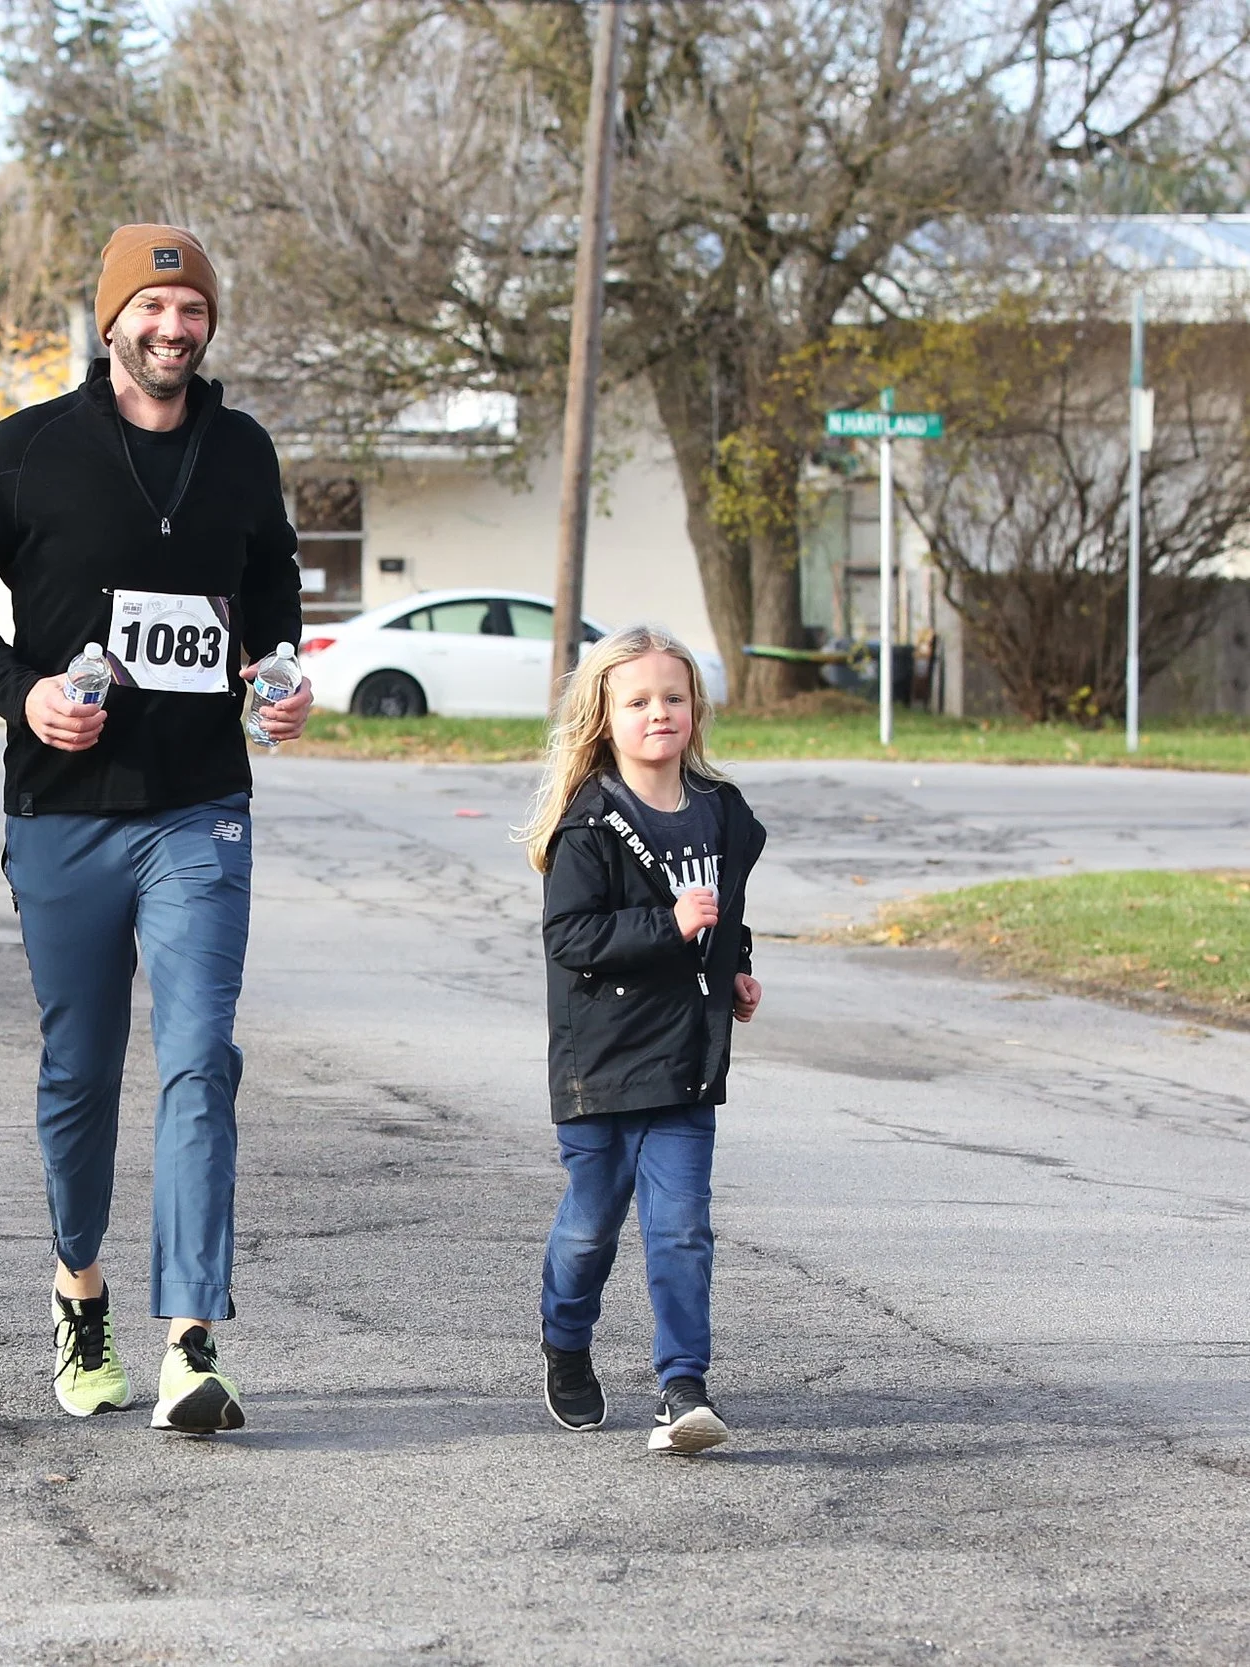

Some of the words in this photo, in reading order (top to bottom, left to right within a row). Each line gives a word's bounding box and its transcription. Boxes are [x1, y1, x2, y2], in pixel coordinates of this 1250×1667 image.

[121, 621, 222, 668] 1083
[603, 810, 633, 838] JUST
[626, 833, 645, 855] DO
[639, 850, 655, 869] IT.
